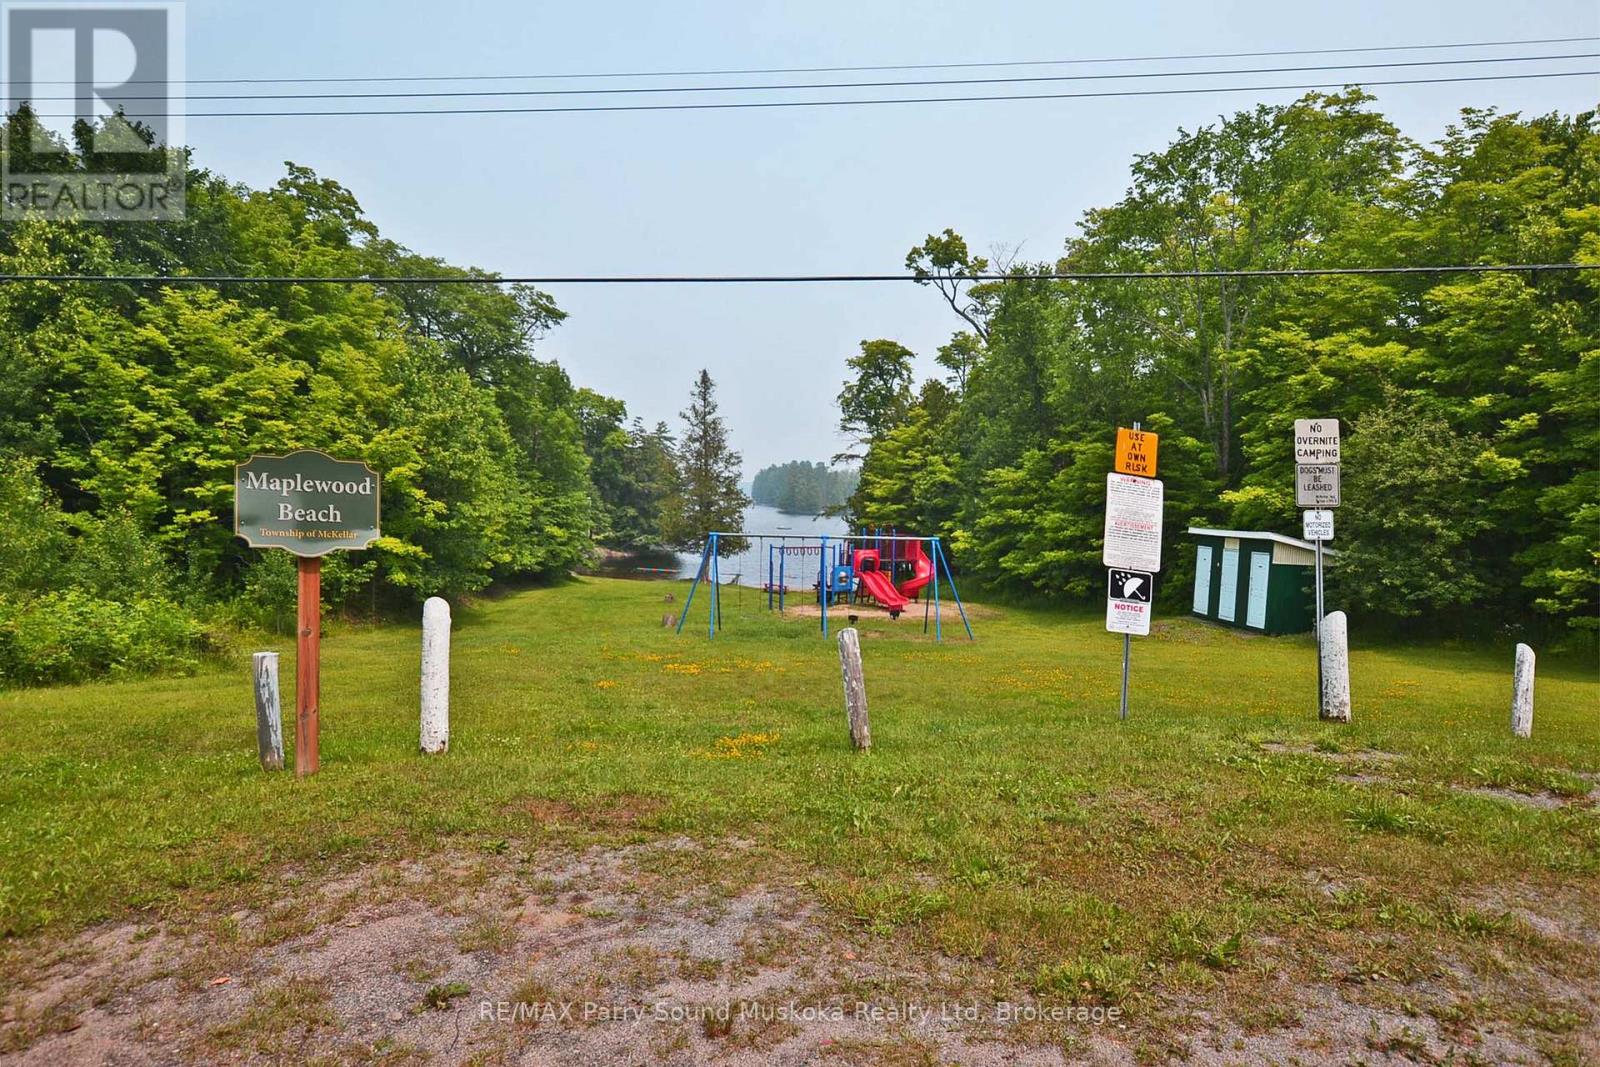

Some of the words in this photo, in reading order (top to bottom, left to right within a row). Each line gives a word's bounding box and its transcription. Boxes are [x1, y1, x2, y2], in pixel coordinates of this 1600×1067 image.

[1309, 424, 1322, 433] NO
[1128, 431, 1145, 442] USE
[1296, 436, 1338, 446] OVERNITE
[1131, 442, 1143, 452] AT
[1127, 452, 1146, 463] OWN
[1297, 449, 1338, 458] CAMPING
[1125, 461, 1148, 473] RISK
[1299, 466, 1317, 474] DOGS
[1318, 466, 1335, 475] MUST
[246, 471, 372, 497] Maplewood
[1313, 475, 1323, 483] BE
[1303, 483, 1333, 492] LEASHED
[277, 502, 342, 523] Beach
[1314, 513, 1322, 521] NO
[259, 528, 305, 540] Township
[306, 528, 317, 538] of
[317, 530, 359, 540] McKellar
[1114, 603, 1144, 613] NOTICE
